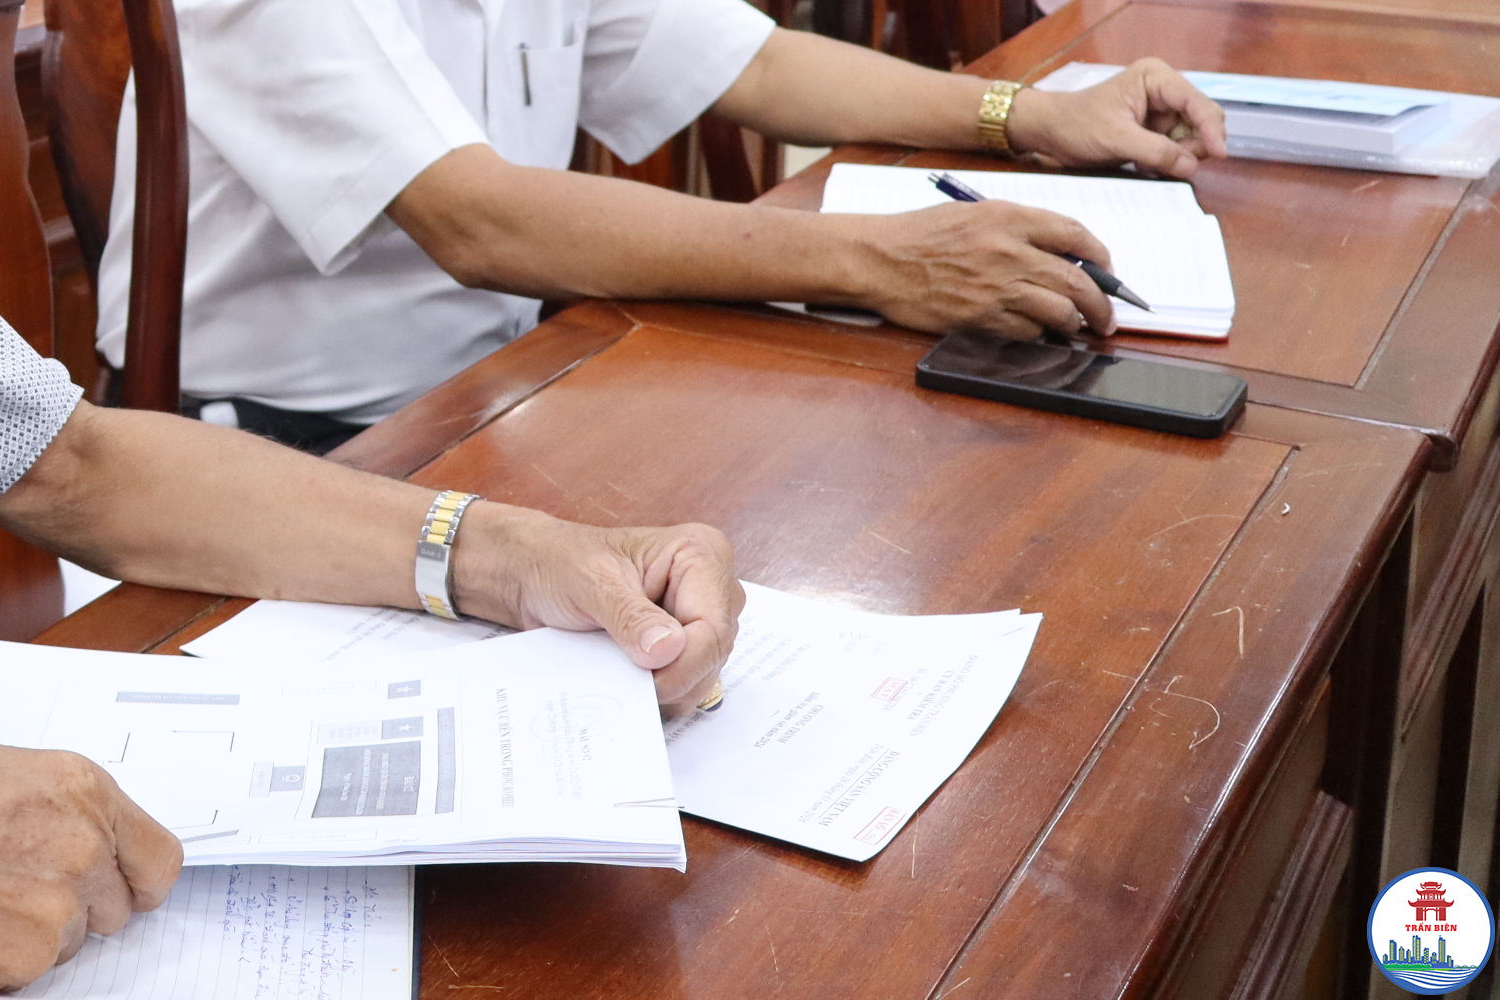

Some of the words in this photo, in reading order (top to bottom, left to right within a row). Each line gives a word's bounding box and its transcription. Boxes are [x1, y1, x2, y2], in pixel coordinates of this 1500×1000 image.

[496, 687, 507, 702] KHU
[498, 722, 513, 737] BÊN
[499, 738, 512, 765] TRONG
[877, 751, 902, 768] ĐẢNG
[857, 766, 884, 785] CỘNG
[846, 784, 868, 799] SẢN
[830, 796, 855, 811] VIỆT
[818, 811, 840, 826] NAM
